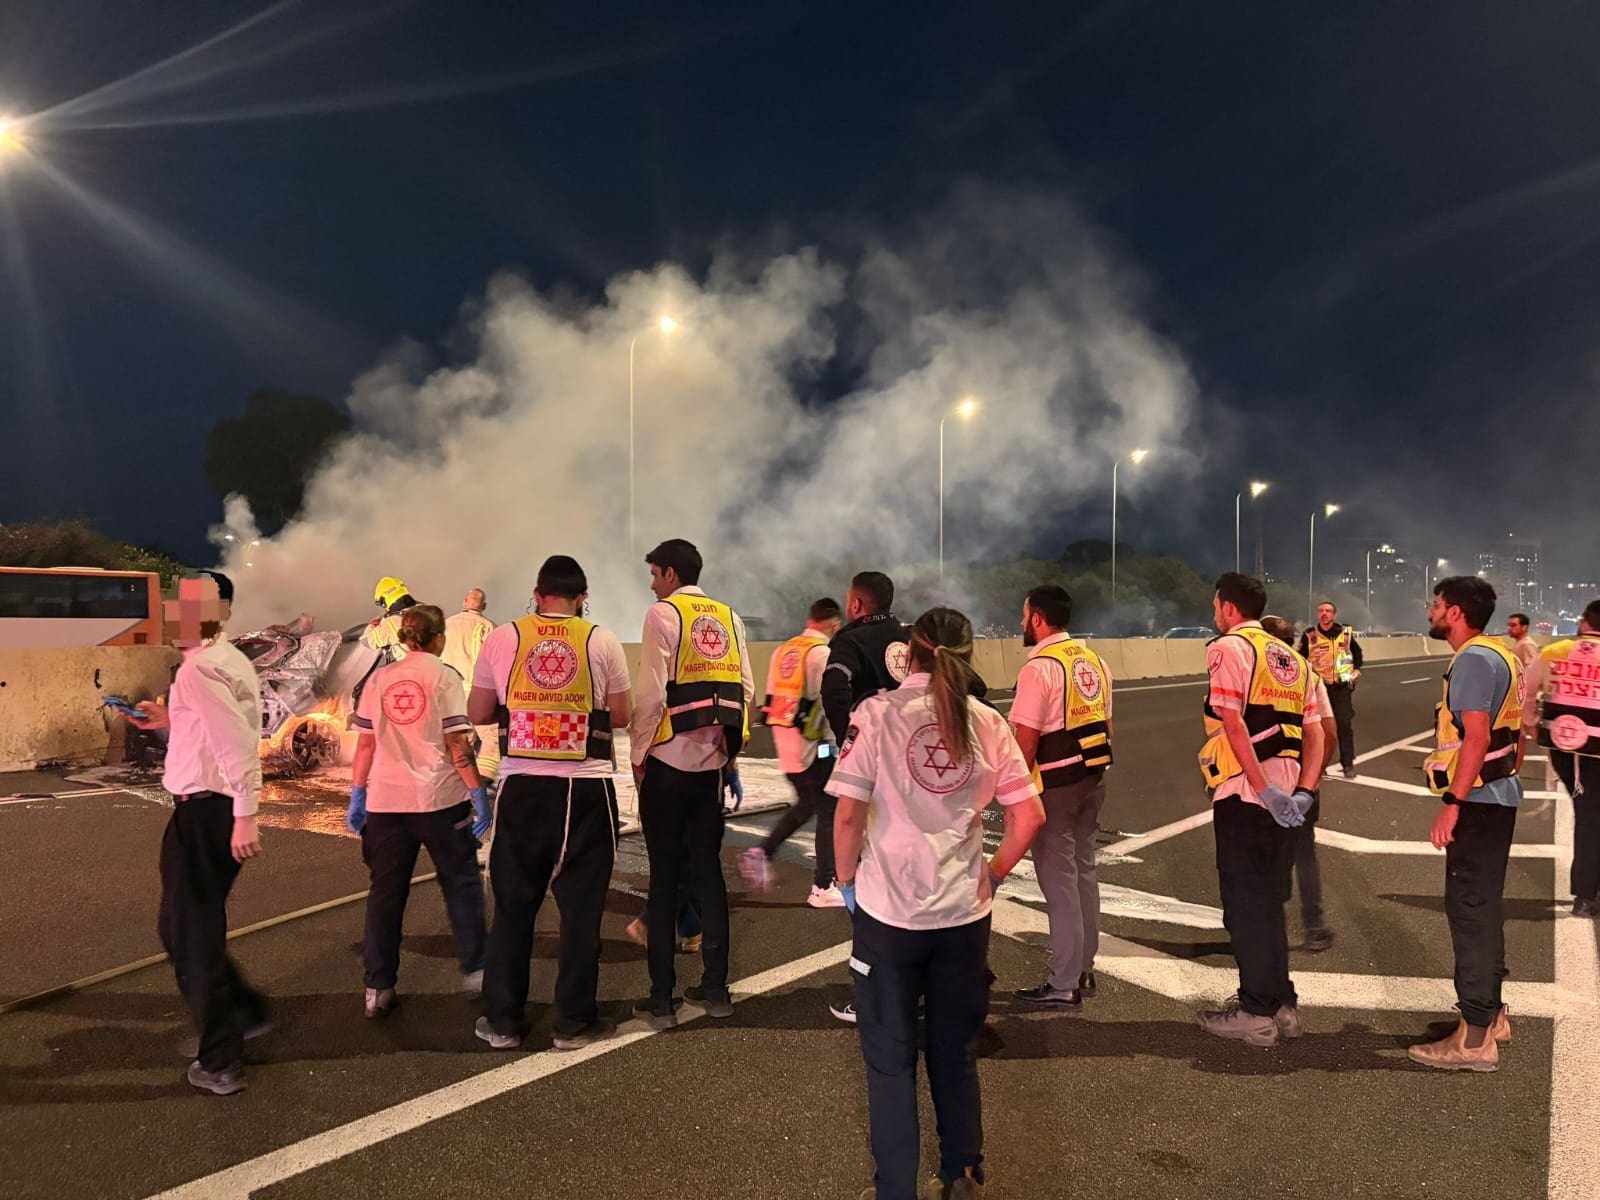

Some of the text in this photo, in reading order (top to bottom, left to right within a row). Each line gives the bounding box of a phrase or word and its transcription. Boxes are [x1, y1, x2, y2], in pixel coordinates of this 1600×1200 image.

[537, 625, 569, 636] חובש
[513, 690, 585, 704] MAGEN DAVID ADOM
[1261, 687, 1303, 702] PARAMEDIC
